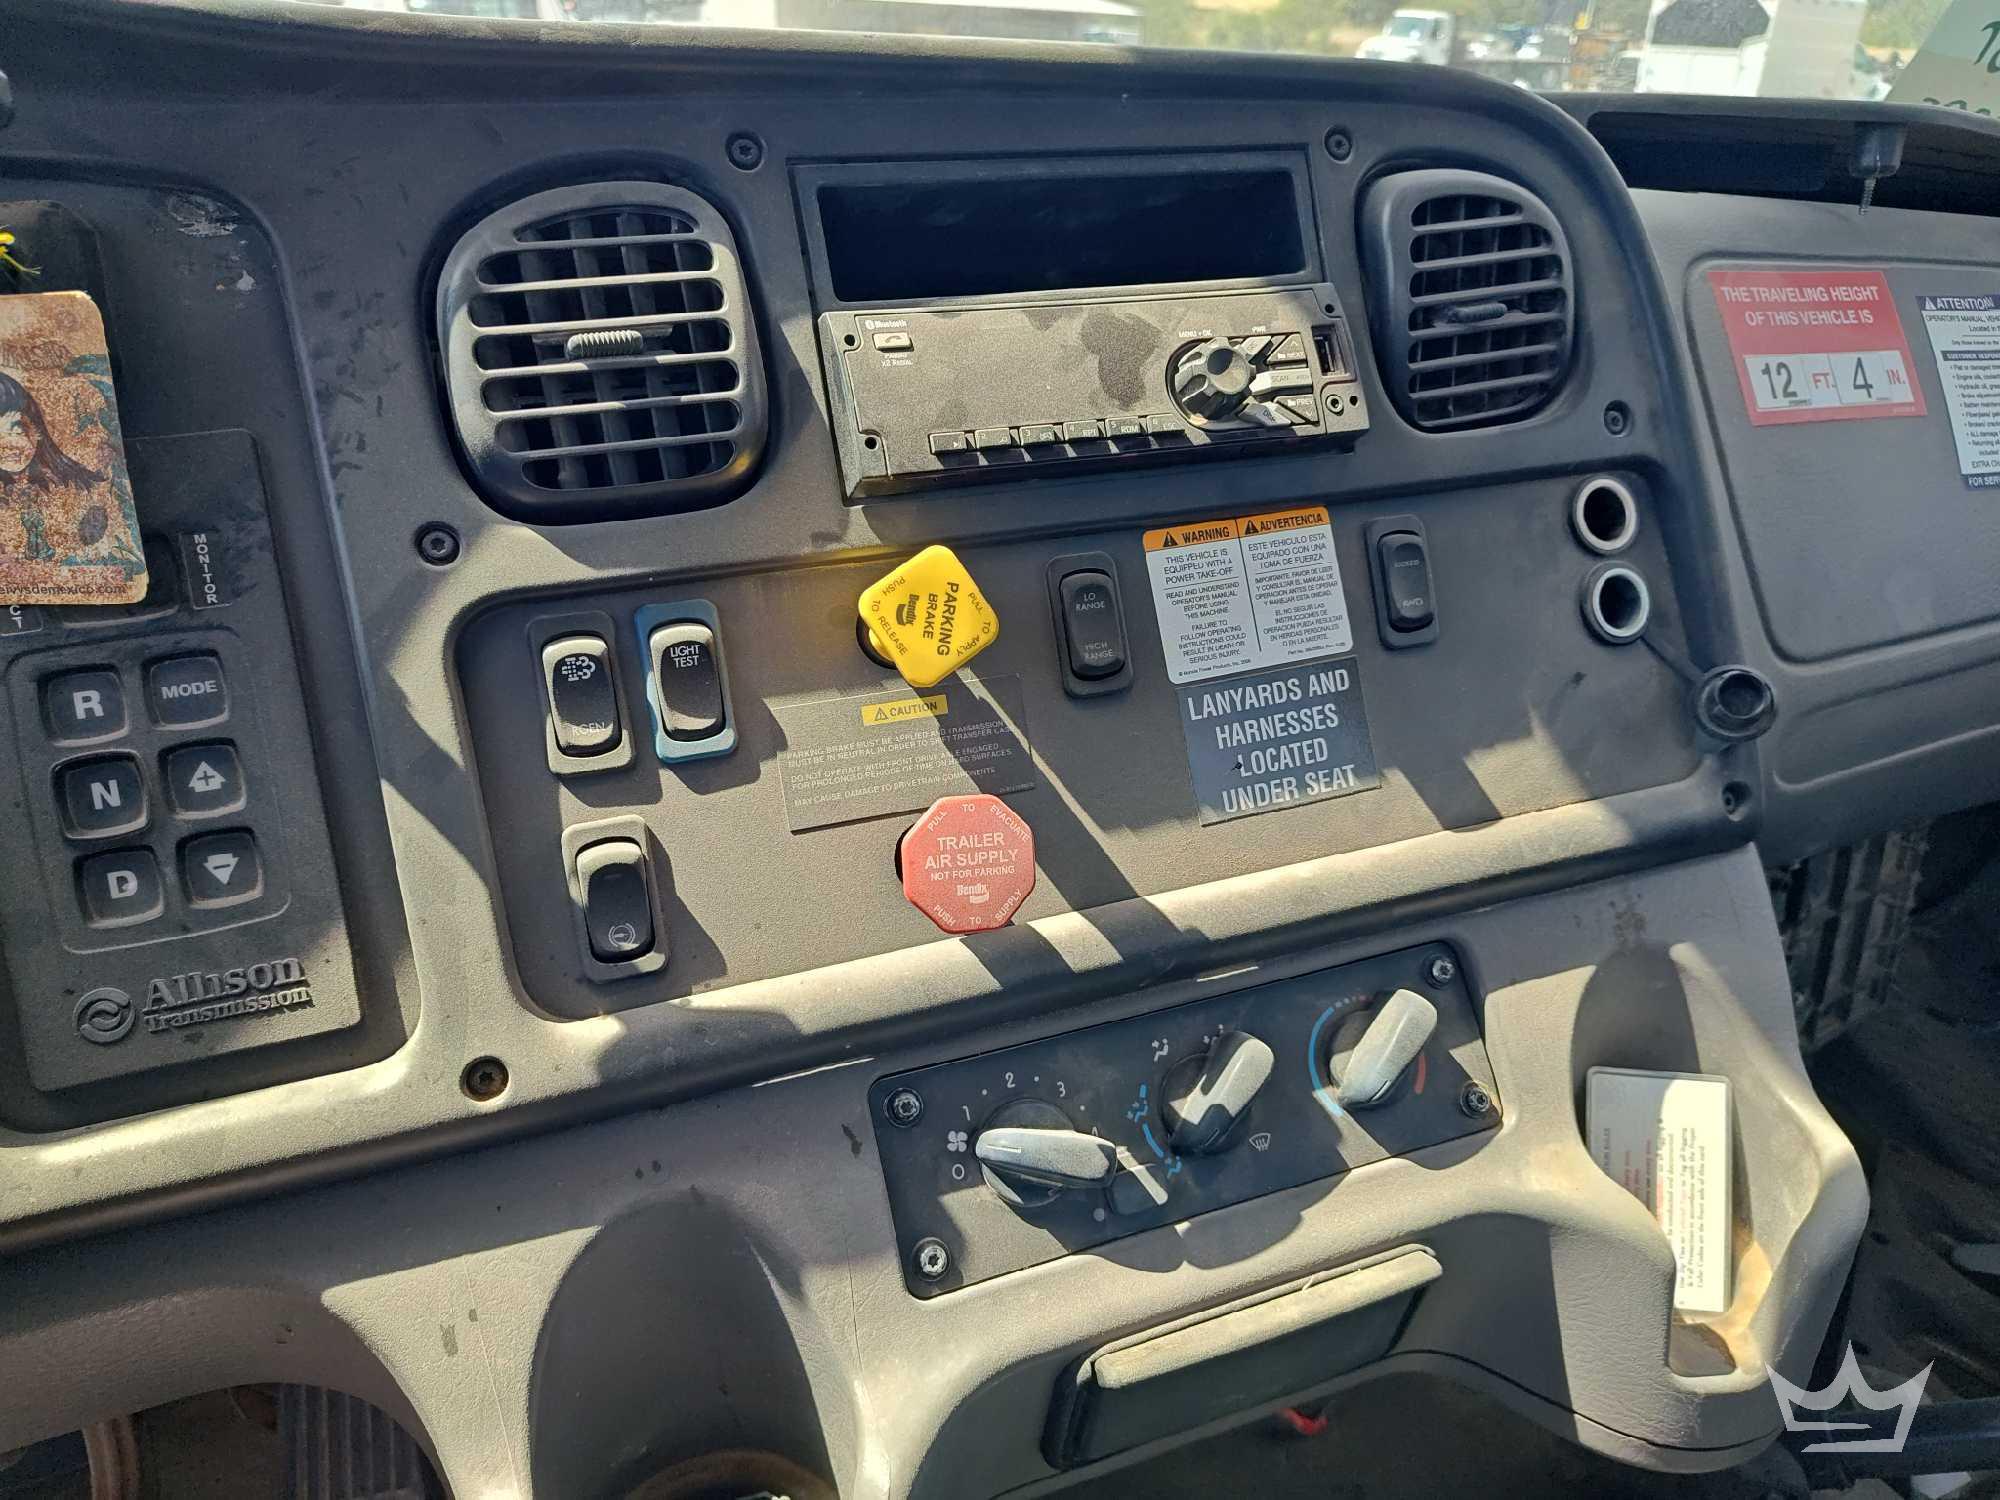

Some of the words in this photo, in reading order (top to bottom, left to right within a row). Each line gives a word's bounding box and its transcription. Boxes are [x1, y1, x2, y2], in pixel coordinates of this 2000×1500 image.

[1721, 287, 1750, 302] THE
[1751, 286, 1828, 302] TRAVELING
[1831, 286, 1879, 301] HEIGHT
[1744, 311, 1767, 326] OF
[1768, 311, 1800, 326] THIS
[1800, 310, 1858, 325] VEHICLE
[1861, 309, 1874, 324] IS
[1761, 361, 1799, 399] 12
[1853, 357, 1874, 399] 4
[1259, 513, 1323, 532] ADVERTENCIA
[1182, 526, 1230, 545] WARNING
[1248, 541, 1268, 552] ESTE
[1269, 535, 1308, 549] VEHICULO
[1308, 532, 1327, 542] ESTA
[1166, 555, 1184, 564] THIS
[1186, 550, 1219, 562] VEHICLE
[1220, 548, 1229, 557] IS
[1252, 547, 1291, 562] EQUIPADO
[1291, 545, 1310, 555] CON
[1310, 542, 1327, 552] UNA
[1282, 557, 1293, 566] DE
[1294, 553, 1324, 564] FUERZA
[194, 535, 219, 604] MONITOR
[1163, 562, 1204, 575] EQUIPPED
[1206, 559, 1226, 569] WITH
[1165, 573, 1196, 585] POWER
[1197, 566, 1233, 579] TAKE-OFF
[881, 575, 906, 597] PUSH
[1185, 588, 1198, 597] AND
[1198, 581, 1240, 594] UNDERSTAND
[871, 599, 881, 613] TO
[967, 592, 984, 617] PULL
[1075, 600, 1105, 611] RANGE
[1083, 592, 1096, 602] LO
[922, 592, 938, 640] BRAKE
[937, 581, 960, 657] PARKING
[877, 615, 908, 656] RELEASE
[982, 621, 991, 635] TO
[1180, 631, 1206, 641] FOLLOW
[1207, 624, 1242, 637] OPERATING
[1225, 632, 1247, 642] COULD
[669, 643, 700, 659] LIGHT
[956, 634, 981, 657] APPLY
[673, 655, 700, 668] TEST
[161, 679, 218, 700] MODE
[1187, 678, 1303, 721] LANYARDS
[1308, 669, 1350, 698] AND
[73, 690, 104, 720] R
[889, 701, 938, 718] CAUTION
[1215, 703, 1339, 750] HARNESSES
[1237, 737, 1329, 777] LOCATED
[91, 780, 121, 811] N
[1221, 776, 1299, 813] UNDER
[1304, 764, 1356, 796] SEAT
[927, 809, 949, 832] PULL
[961, 803, 976, 813] TO
[989, 804, 1032, 843] EVACUATE
[937, 831, 1006, 851] TRAILER
[924, 854, 953, 870] AIR
[956, 848, 1019, 867] SUPPLY
[930, 871, 951, 881] NOT
[952, 869, 973, 880] FOR
[974, 865, 1016, 878] PARKING
[106, 870, 138, 900] D
[956, 882, 988, 897] Bendix
[933, 904, 957, 927] PUSH
[969, 915, 983, 926] TO
[994, 888, 1023, 921] SUPPLY
[142, 956, 307, 1013] Allison
[143, 986, 312, 1033] Transmission
[1005, 1072, 1017, 1089] 2
[1056, 1081, 1066, 1098] 3
[962, 1105, 972, 1121] 1
